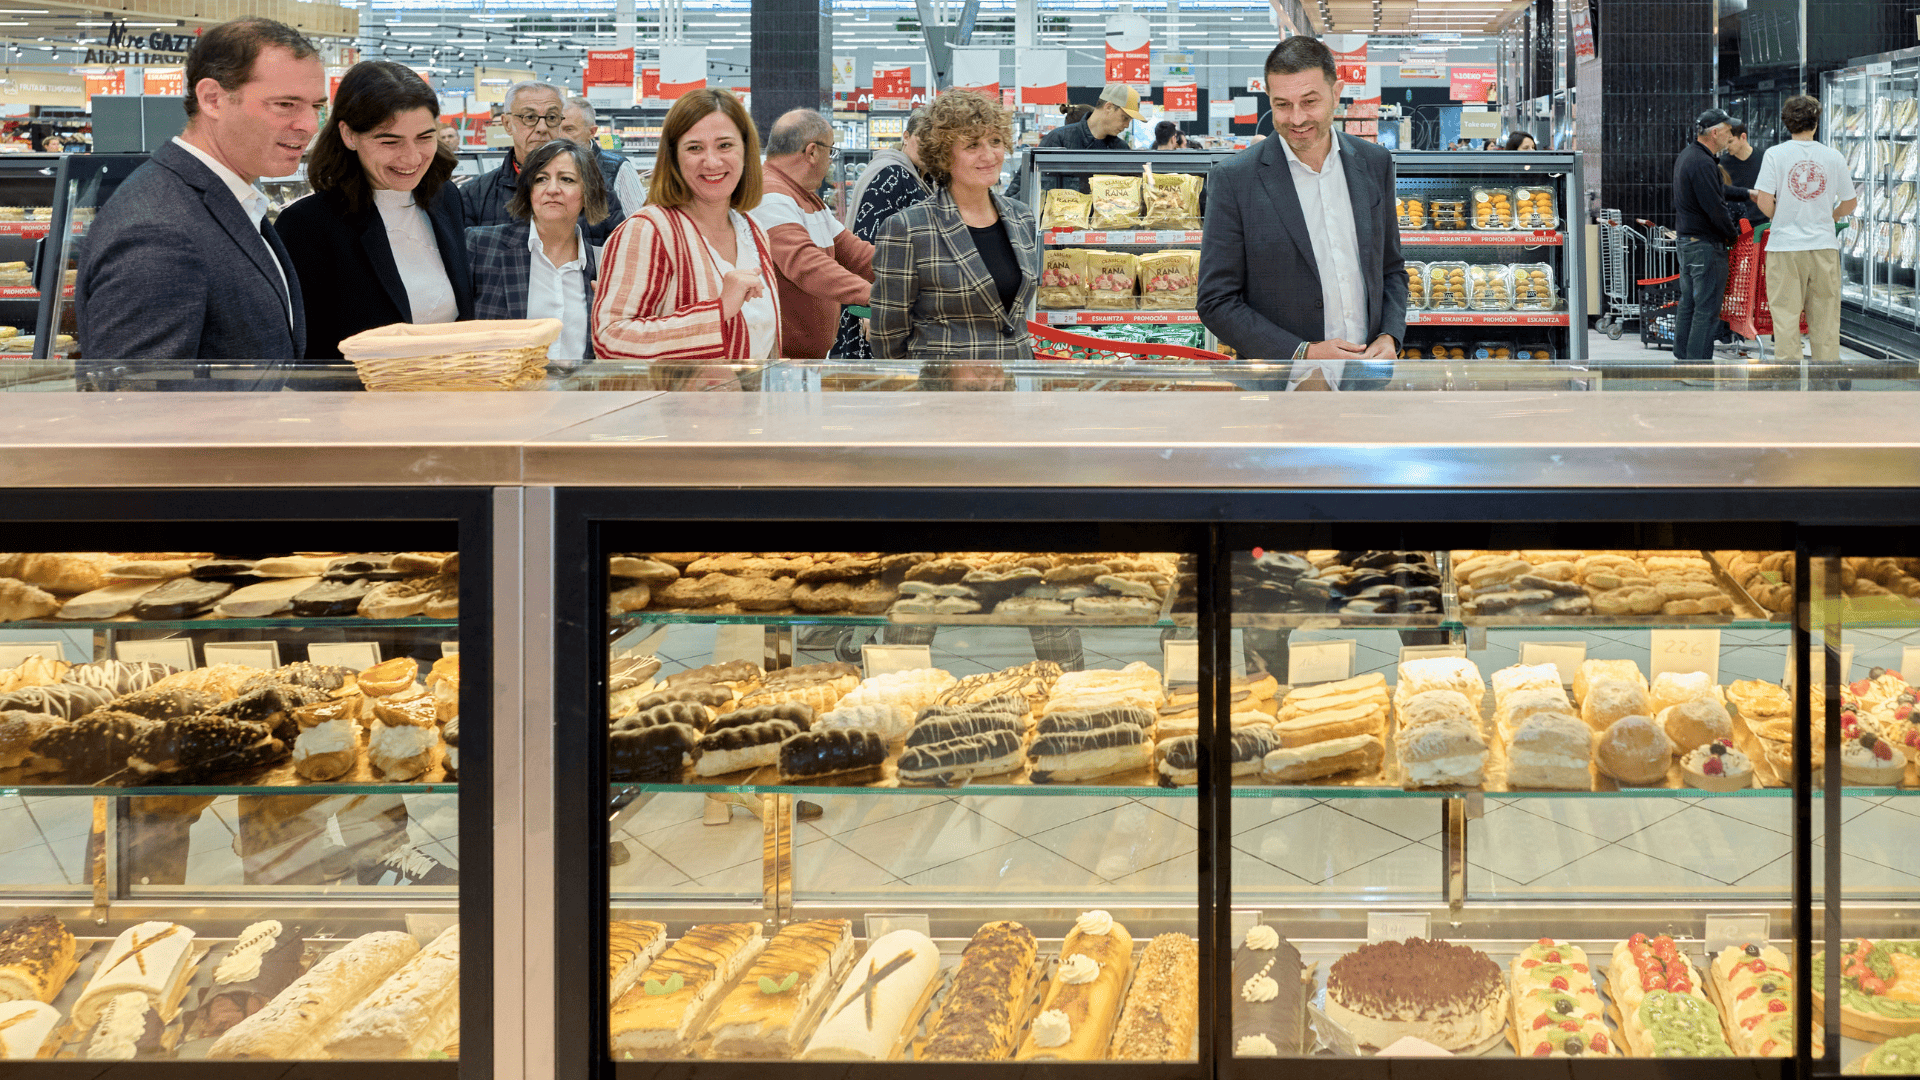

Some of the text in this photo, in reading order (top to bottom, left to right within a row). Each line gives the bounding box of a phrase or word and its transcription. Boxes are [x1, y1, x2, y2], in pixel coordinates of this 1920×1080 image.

[149, 31, 196, 53] GAZT
[20, 83, 39, 92] FRUTA
[39, 84, 48, 92] DE
[1480, 122, 1498, 130] away
[1105, 189, 1129, 197] RANA
[1158, 184, 1182, 193] RANA
[1481, 234, 1516, 242] PROMOCIÓN
[1047, 261, 1070, 270] RANA
[1101, 267, 1125, 275] RANA
[1156, 267, 1180, 276] RANA
[1133, 313, 1168, 321] PROMOCIÓN
[1483, 314, 1518, 323] PROMOCIÓN
